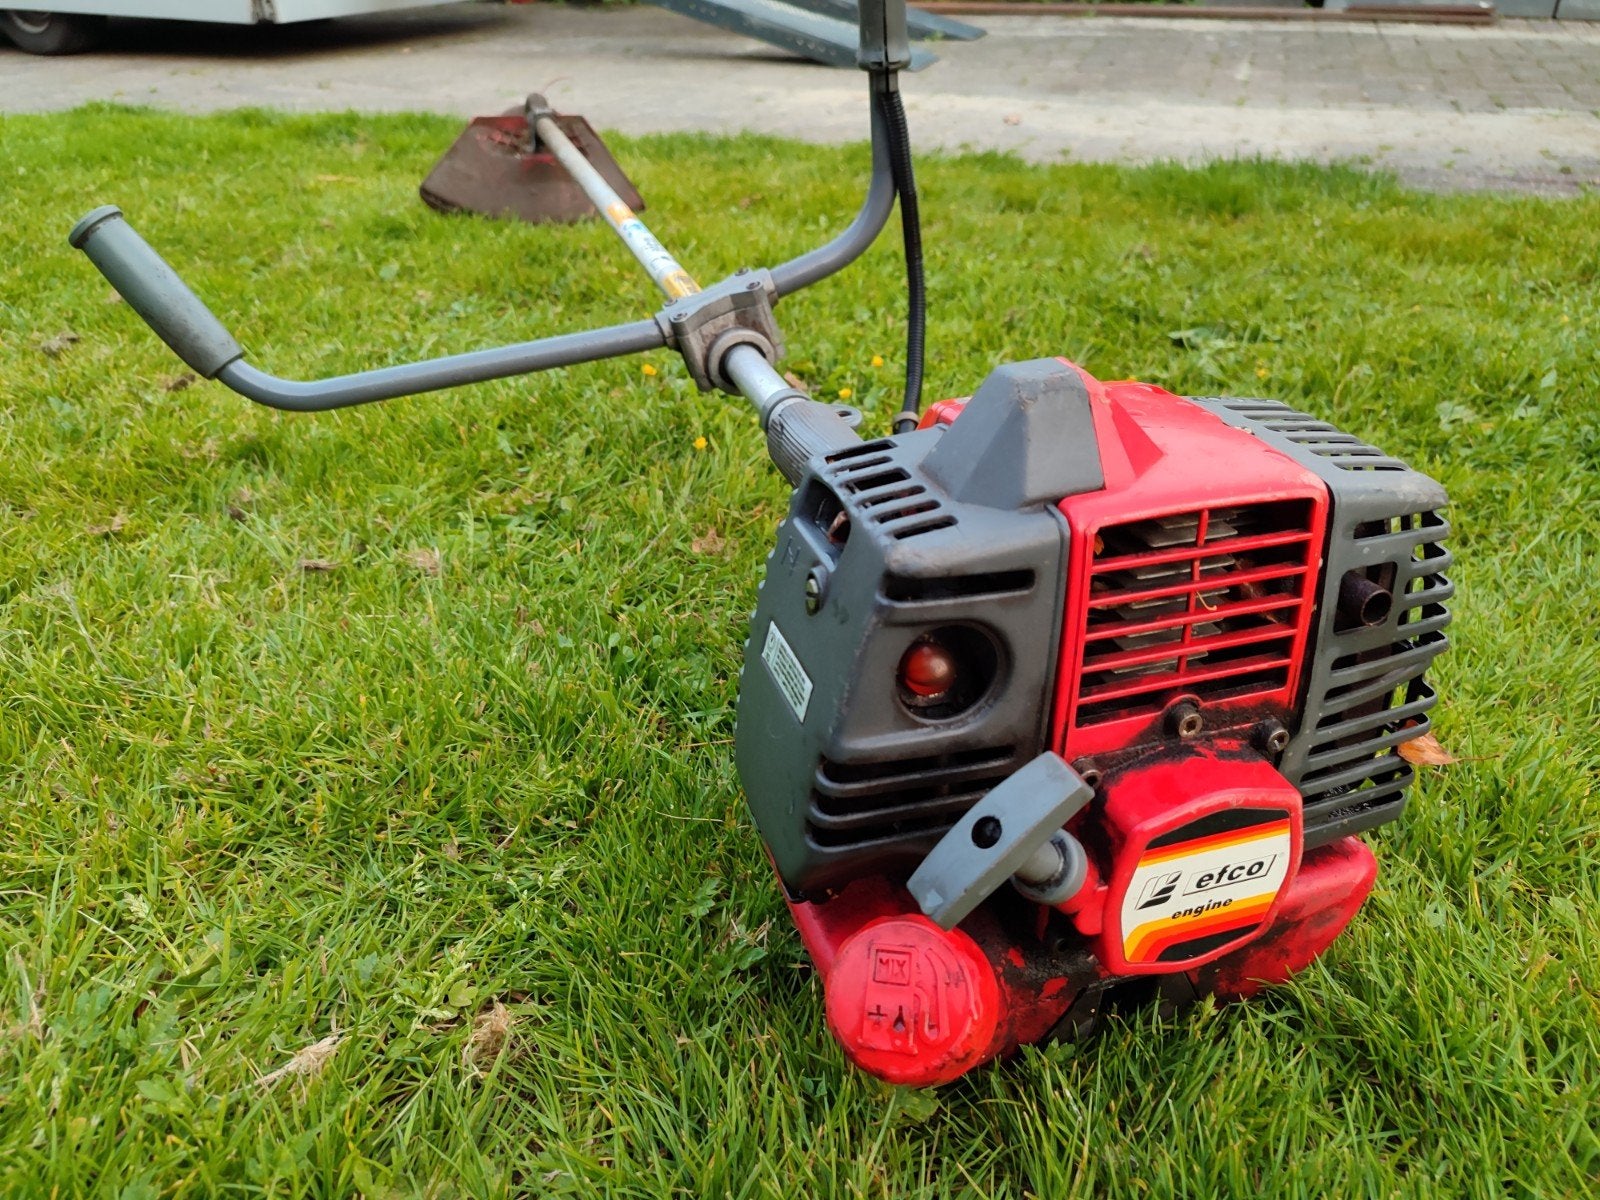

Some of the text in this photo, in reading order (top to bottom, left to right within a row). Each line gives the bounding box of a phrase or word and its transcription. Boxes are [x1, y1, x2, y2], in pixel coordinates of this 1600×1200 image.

[1196, 860, 1264, 889] efco
[1171, 898, 1233, 920] engine
[879, 957, 907, 980] MIX
